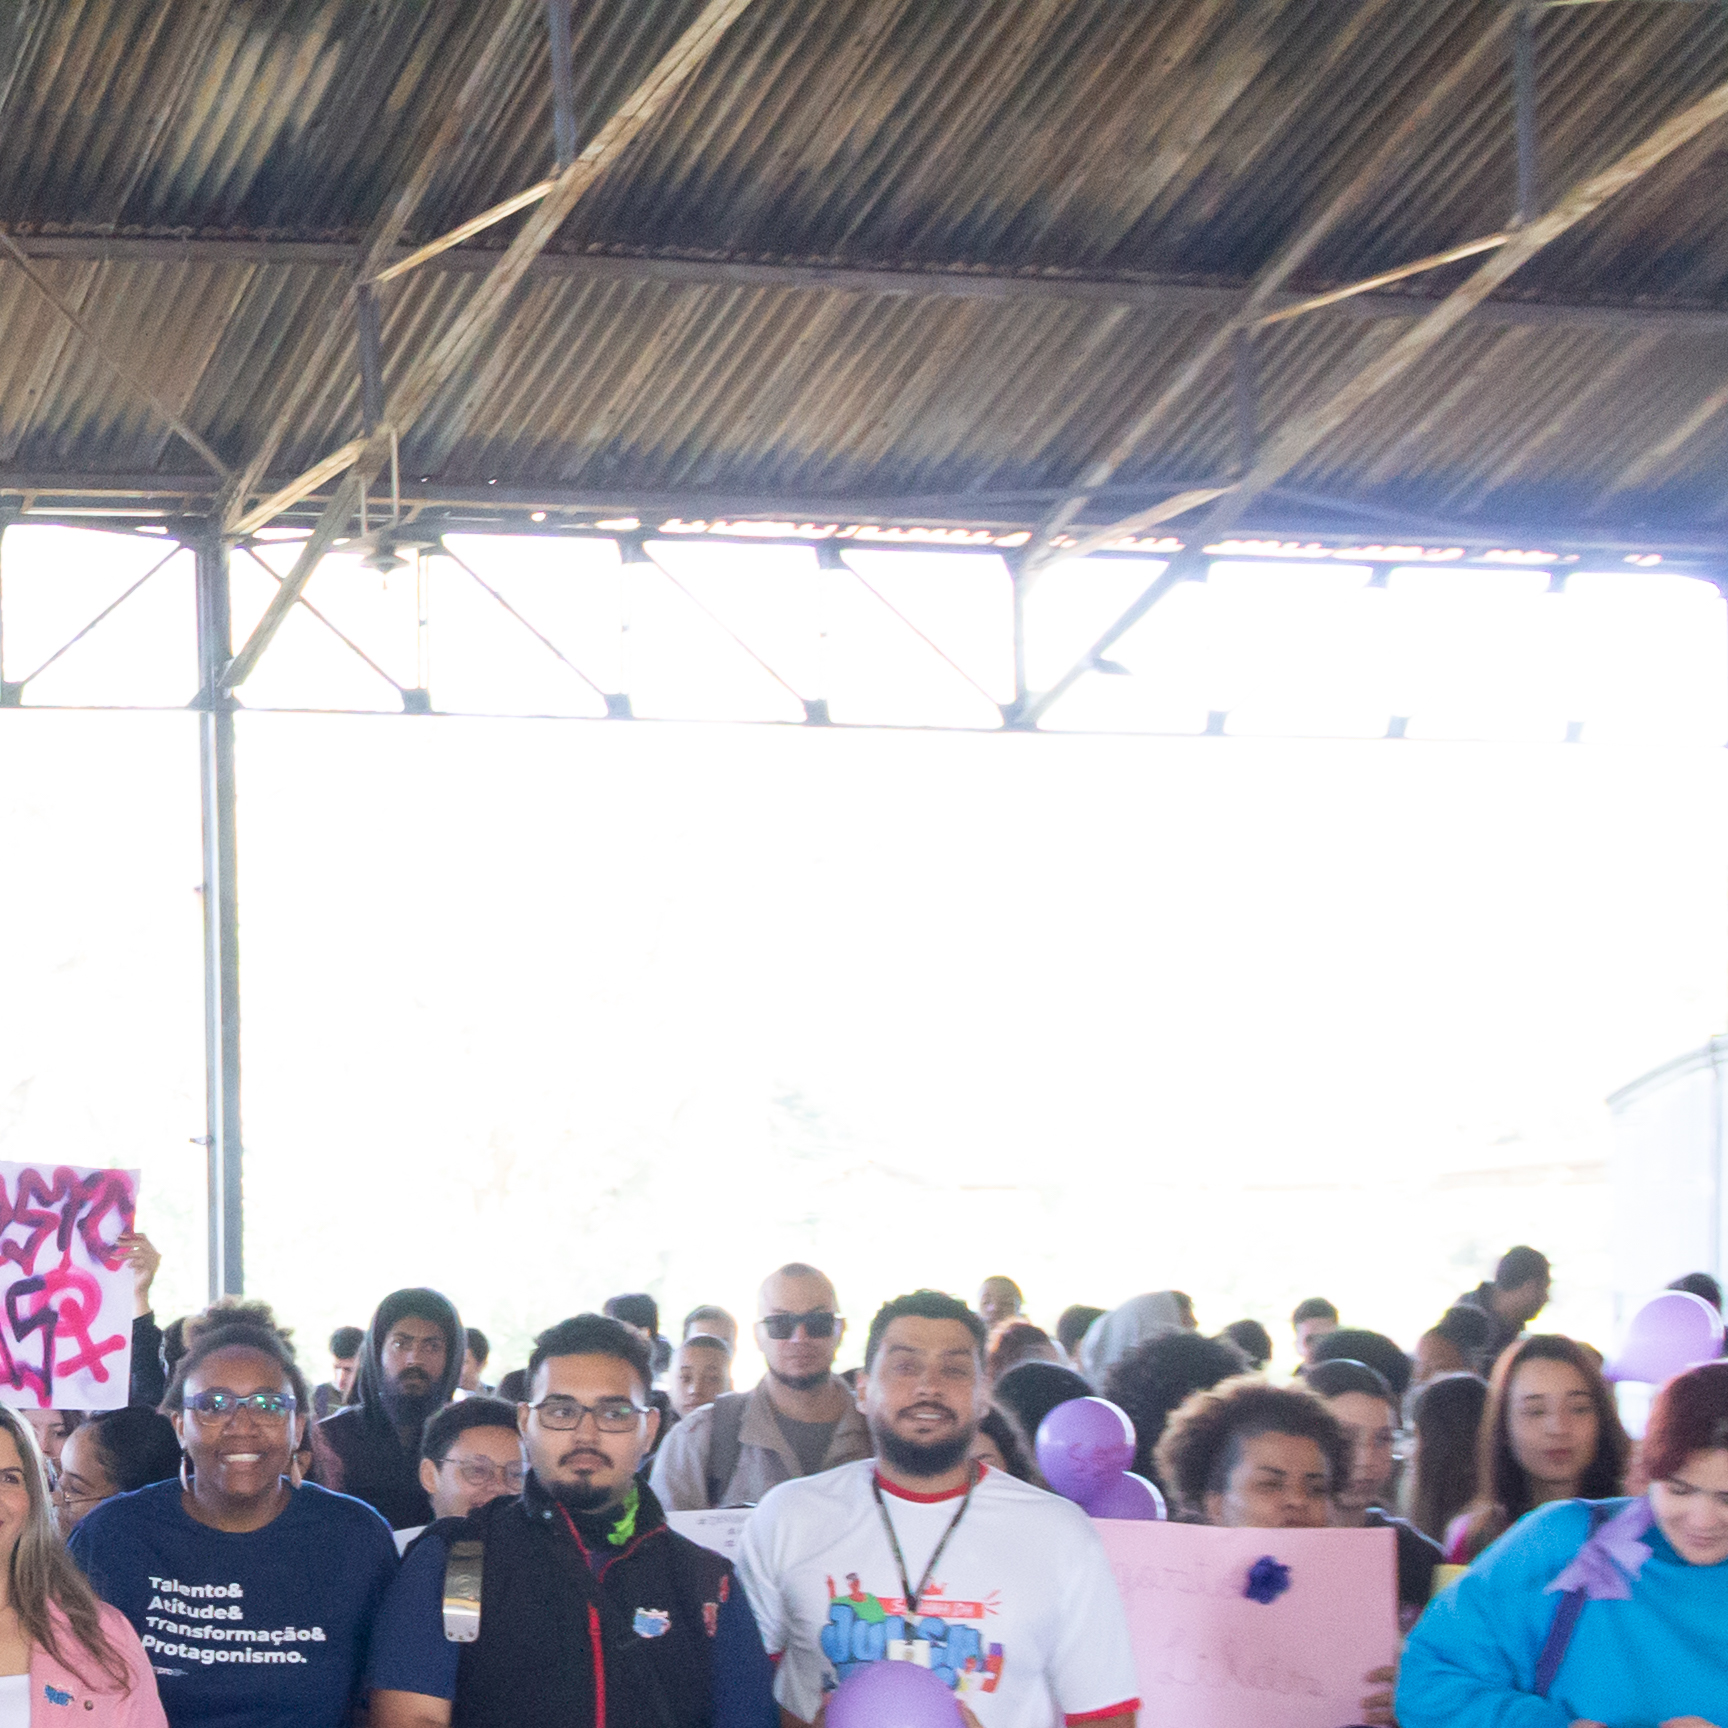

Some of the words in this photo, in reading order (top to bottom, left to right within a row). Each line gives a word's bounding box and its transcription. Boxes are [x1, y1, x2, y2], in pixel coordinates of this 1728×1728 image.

[148, 1576, 244, 1599] Talento&
[147, 1595, 244, 1620] Atitude&
[145, 1616, 327, 1646] Transformação&
[142, 1634, 308, 1665] Protagonismo.
